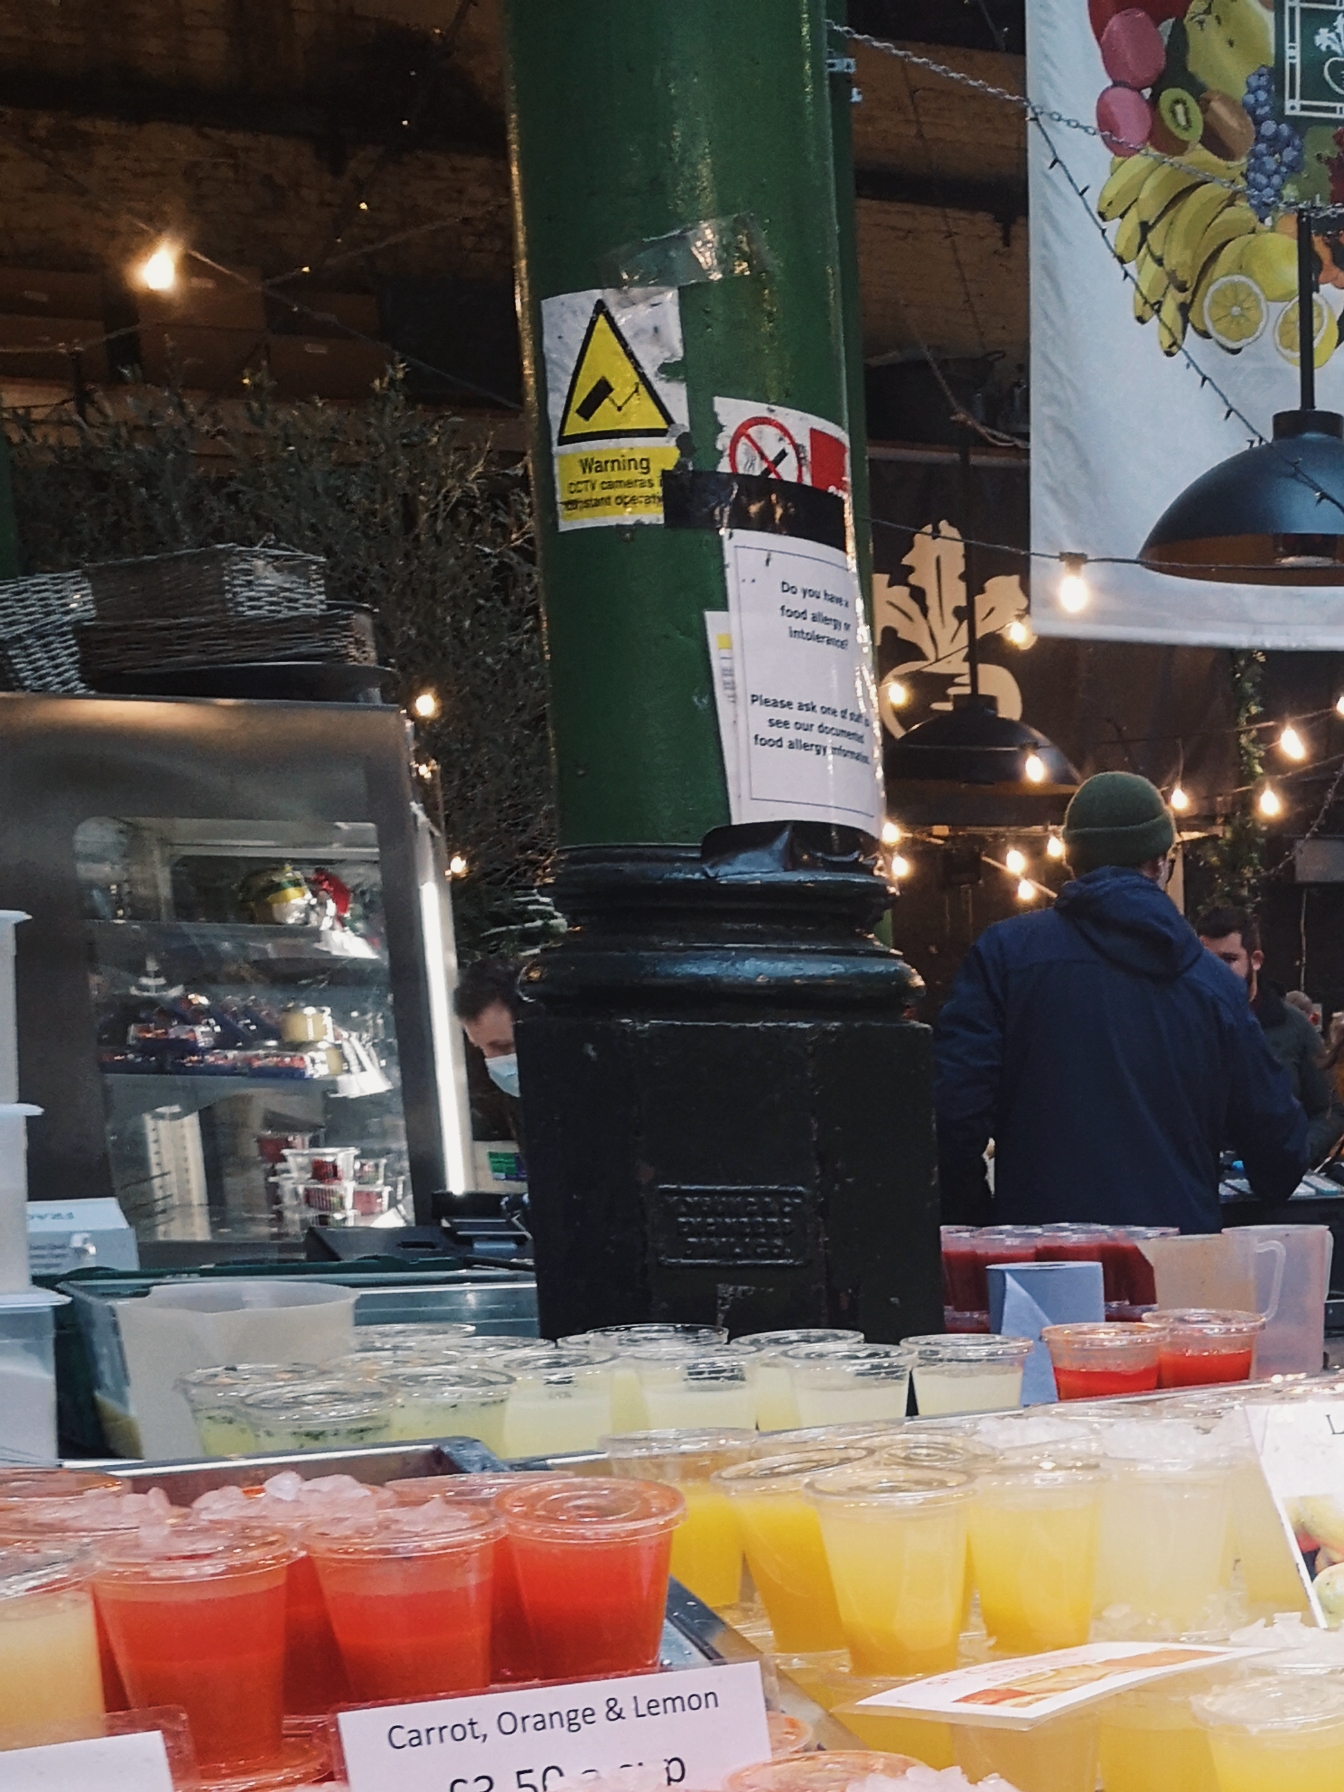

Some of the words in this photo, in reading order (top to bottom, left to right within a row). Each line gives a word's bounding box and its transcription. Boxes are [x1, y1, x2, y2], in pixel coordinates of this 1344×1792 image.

[579, 455, 650, 475] Warning
[600, 478, 655, 490] cameras
[781, 580, 798, 595] Do
[801, 586, 821, 600] you
[780, 604, 807, 620] food
[811, 612, 842, 631] allergy
[751, 694, 794, 710] Please
[797, 700, 818, 714] ask
[820, 705, 838, 718] one
[768, 717, 790, 729] see
[794, 721, 815, 732] our
[754, 734, 783, 749] food
[788, 738, 828, 756] allergy
[387, 1717, 488, 1751] Carrot,
[496, 1705, 597, 1736] Orange
[604, 1697, 626, 1722] &
[632, 1689, 719, 1720] Lemon
